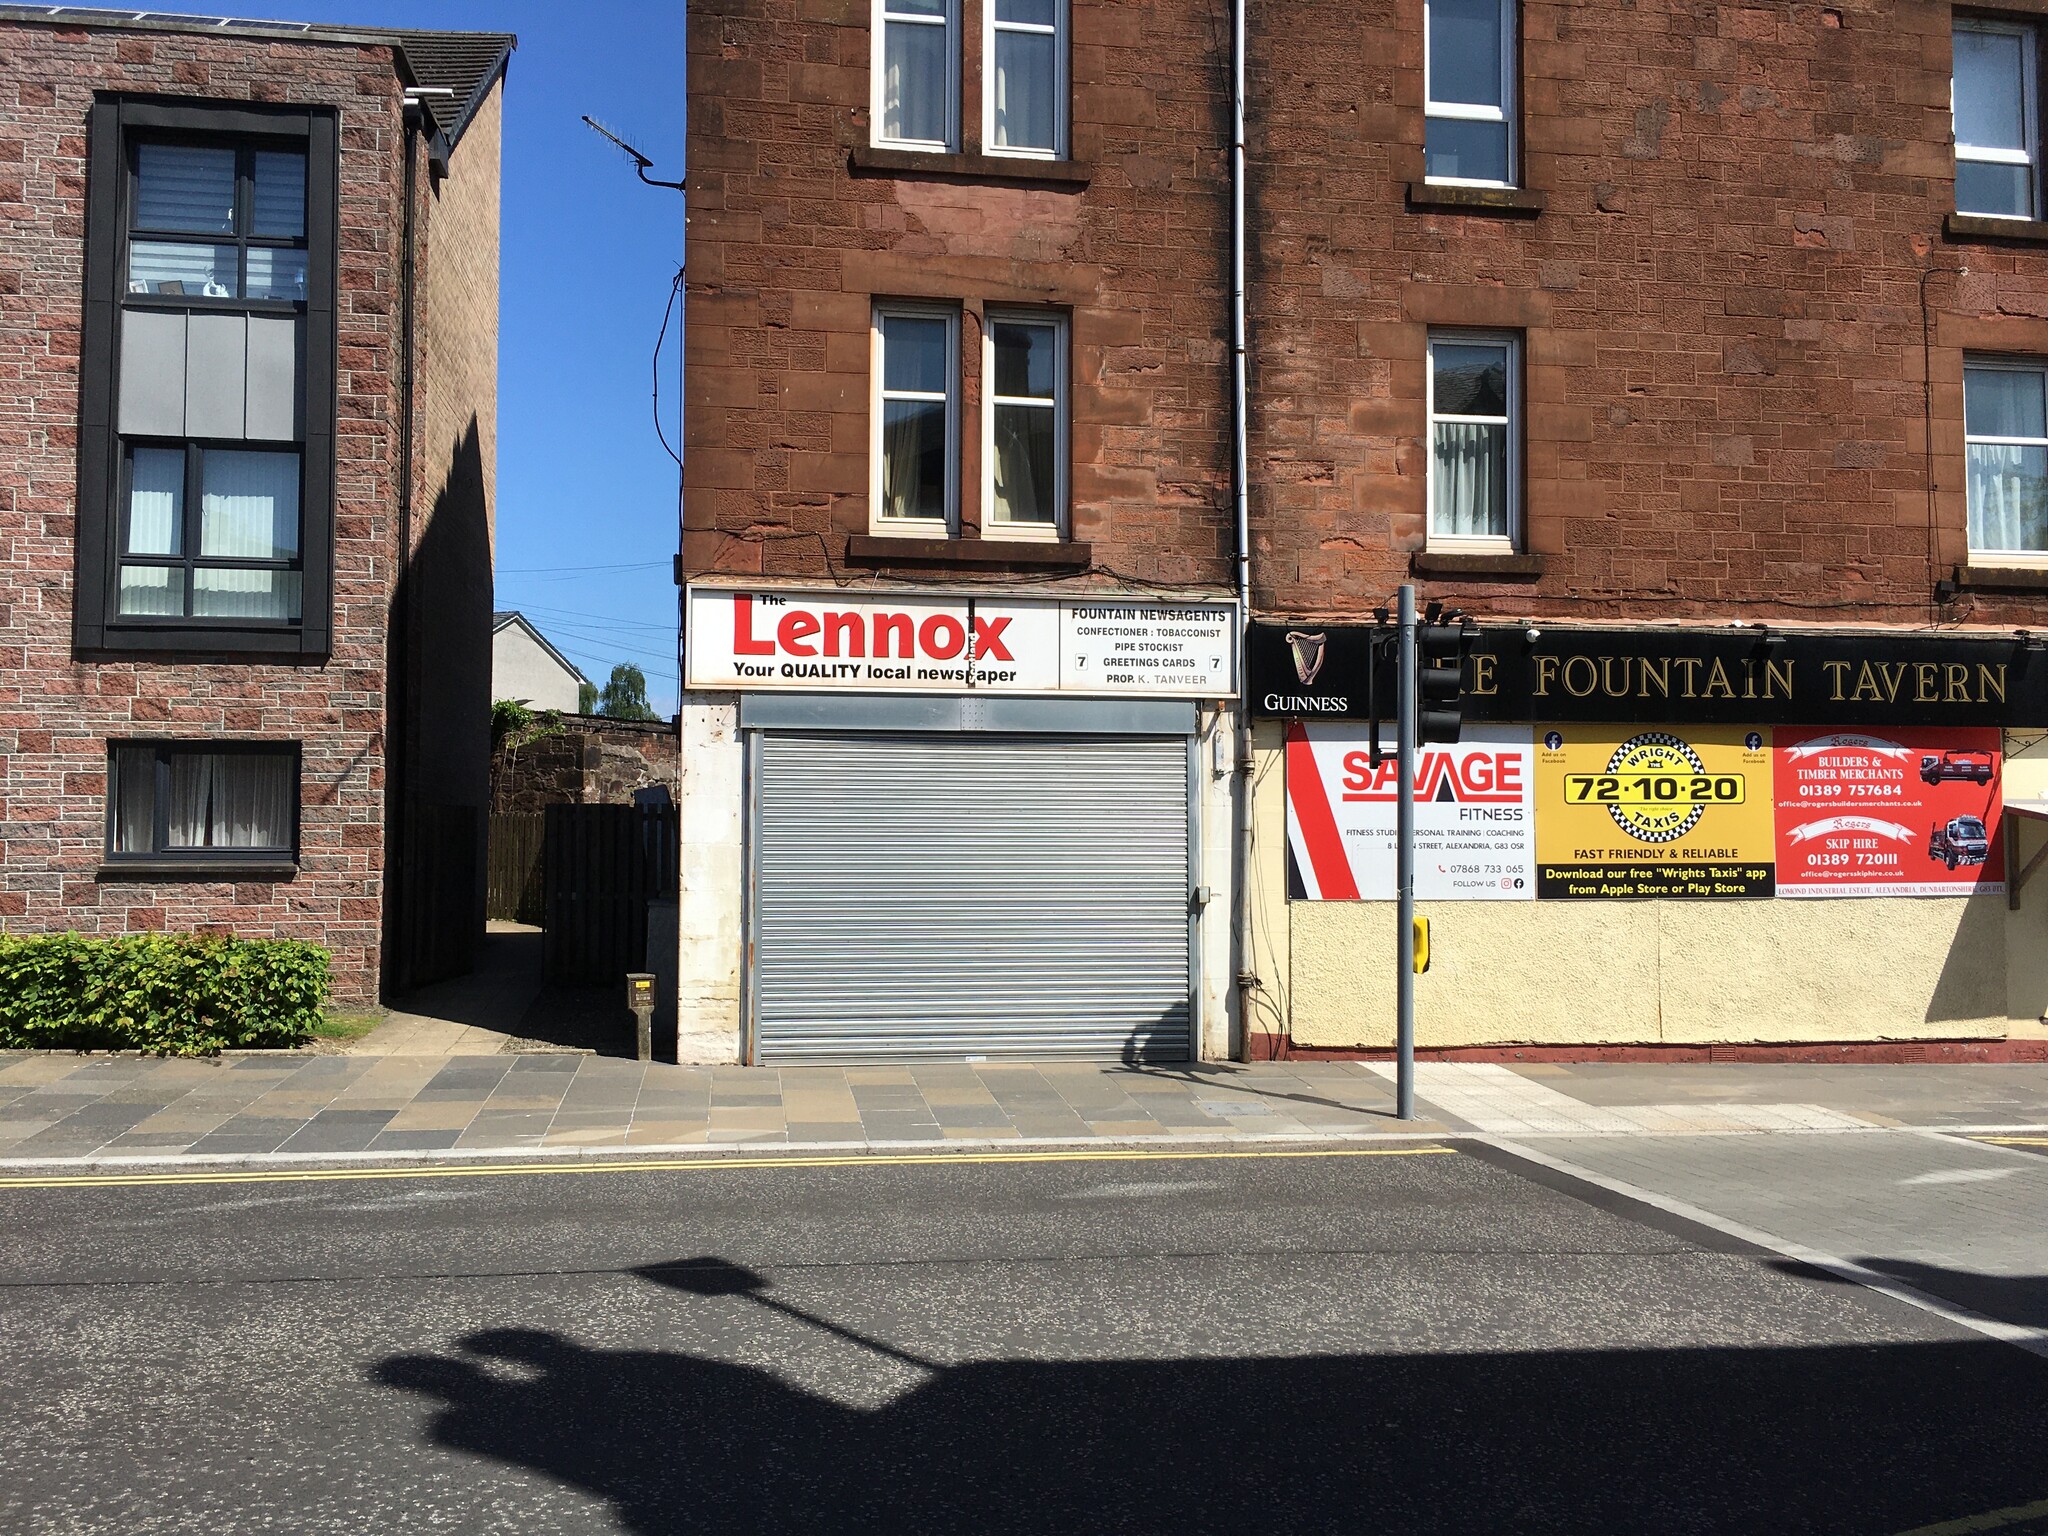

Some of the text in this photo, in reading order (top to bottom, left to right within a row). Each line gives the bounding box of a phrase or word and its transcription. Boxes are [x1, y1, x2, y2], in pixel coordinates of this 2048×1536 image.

[760, 594, 787, 606] The
[1072, 608, 1226, 622] FOUNTAIN NEWSAGENTS
[733, 593, 1016, 662] Lennox
[1077, 627, 1148, 637] CONFECTIONER
[1156, 628, 1221, 638] TOBACCONIST
[1115, 643, 1183, 652] PIPE STOCKIST
[1077, 656, 1086, 667] 7
[1103, 657, 1195, 668] GREETINGS CARDS
[1211, 658, 1220, 669] 7
[733, 662, 777, 677] Your
[780, 663, 861, 679] QUALITY
[867, 664, 911, 680] local
[1107, 674, 1207, 685] PROP. K. TANVEER
[1532, 654, 1796, 700] FOUNTAIN
[1822, 659, 2008, 704] TAVERN
[1830, 735, 1869, 747] Rogers
[1627, 747, 1683, 767] WRIGHT
[1818, 756, 1882, 767] BUILDERS &
[1796, 768, 1904, 780] TIMBER MERCHANTS
[1799, 784, 1902, 796] 01389 757684
[1778, 800, 1923, 808] office@rogersbuildersmerchants.co.uk
[1459, 808, 1523, 821] FITNESS
[1634, 811, 1680, 828] TAXIS
[1832, 818, 1872, 830] Rogers
[1346, 829, 1525, 838] FITNESS STUDI ERSONAL TRAINING COACHING
[1418, 842, 1444, 851] STREET,
[1446, 842, 1492, 851] ALEXANDRIA,
[1494, 842, 1509, 850] G83
[1825, 838, 1879, 849] SKIP HIRE
[1574, 848, 1738, 859] FAST FRIENDLY & RELIABLE
[1807, 853, 1898, 865] 01389 720111
[1450, 864, 1524, 873] 07868 733 065
[1800, 869, 1905, 878] office@rogersskiphire.co.uk
[1545, 868, 1604, 879] Download
[1606, 871, 1627, 879] our
[1629, 868, 1653, 879] free
[1746, 869, 1767, 881] app
[1453, 880, 1496, 888] FOLLOW US
[1569, 883, 1746, 896] from Apple Store or Play Store
